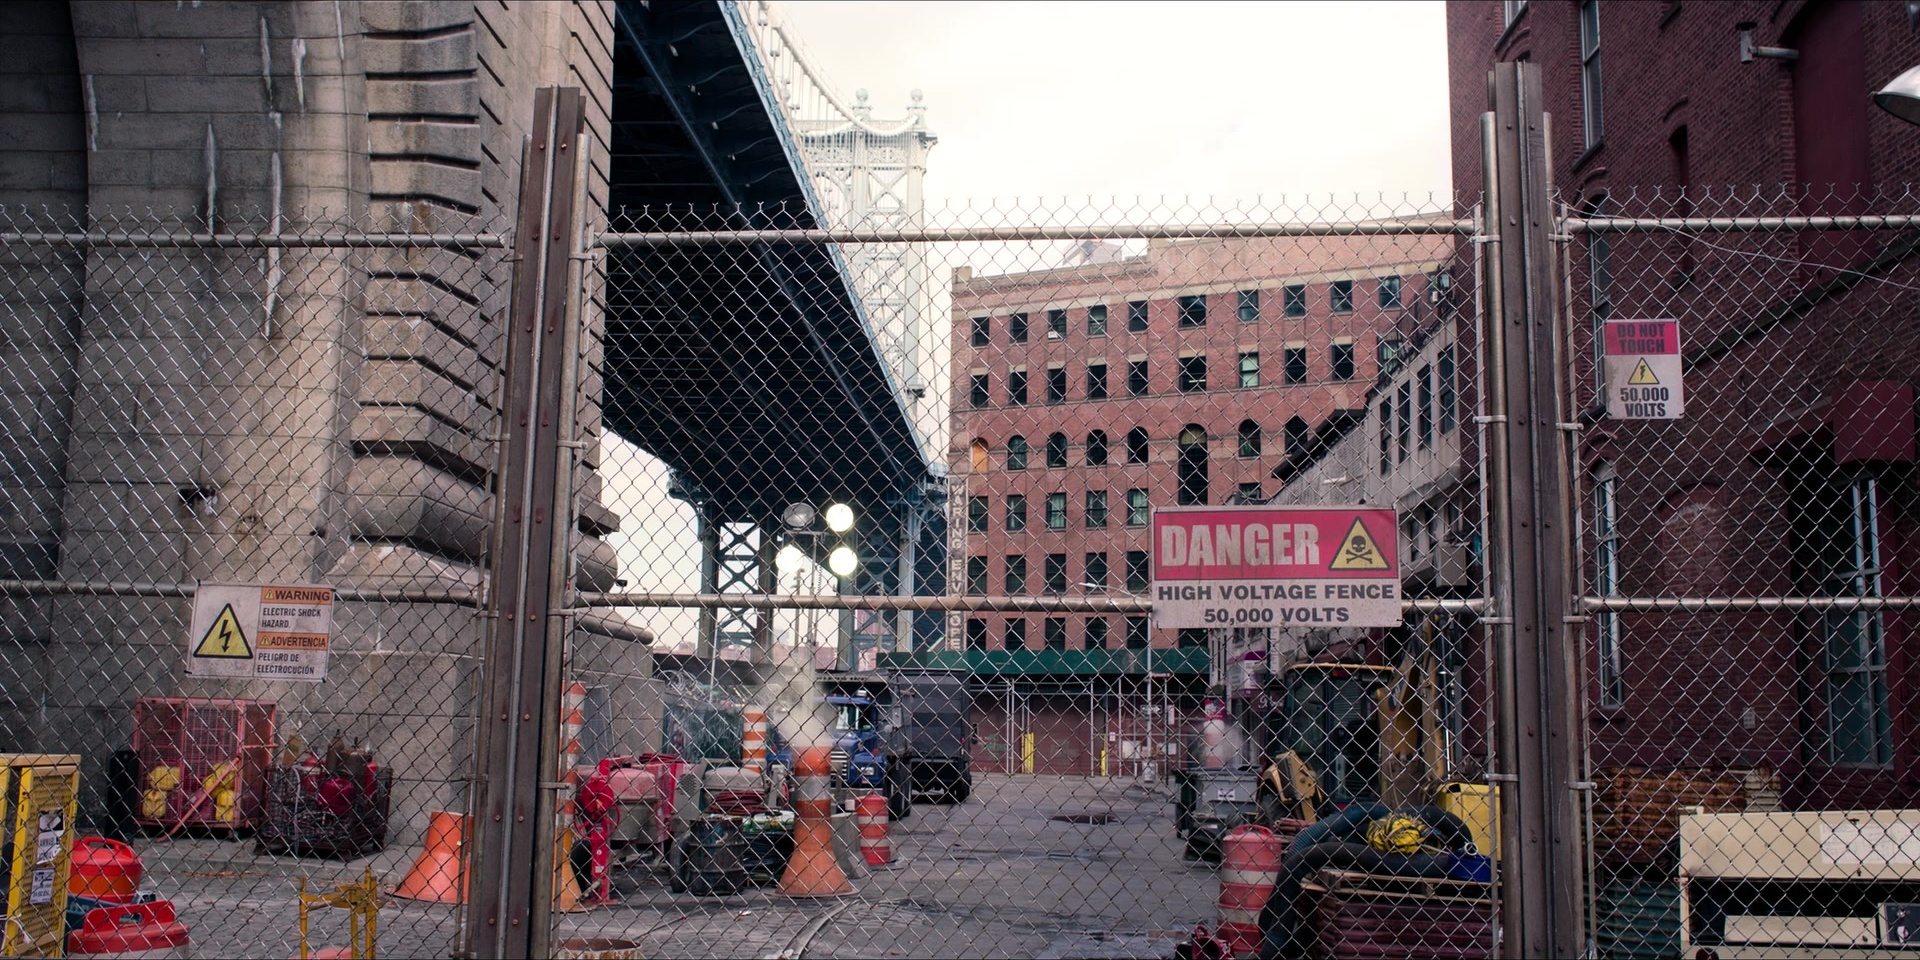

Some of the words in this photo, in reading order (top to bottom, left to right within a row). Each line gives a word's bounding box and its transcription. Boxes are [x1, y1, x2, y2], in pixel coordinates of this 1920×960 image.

[1617, 323, 1636, 338] DO
[1639, 323, 1666, 338] NOT
[1620, 338, 1666, 353] TOUCH
[1620, 386, 1669, 402] 50,000
[1625, 402, 1666, 417] VOLTS
[1161, 523, 1320, 567] DANGER
[275, 590, 331, 602] WARNING
[1158, 585, 1212, 600] HIGH
[1219, 584, 1317, 600] VOLTAGE
[1325, 584, 1394, 599] FENCE
[262, 607, 297, 617] ELECTRIC
[298, 608, 322, 618] SHOCK
[949, 559, 963, 651] ENVOPE
[1204, 607, 1274, 625] 50,000
[1280, 606, 1350, 623] VOLTS
[261, 619, 291, 629] HAZARD.
[270, 636, 326, 648] ADVERTENCIA
[258, 652, 289, 662] PELIGRO
[290, 653, 300, 663] DE
[257, 664, 315, 675] ELECTROCUCIÓN
